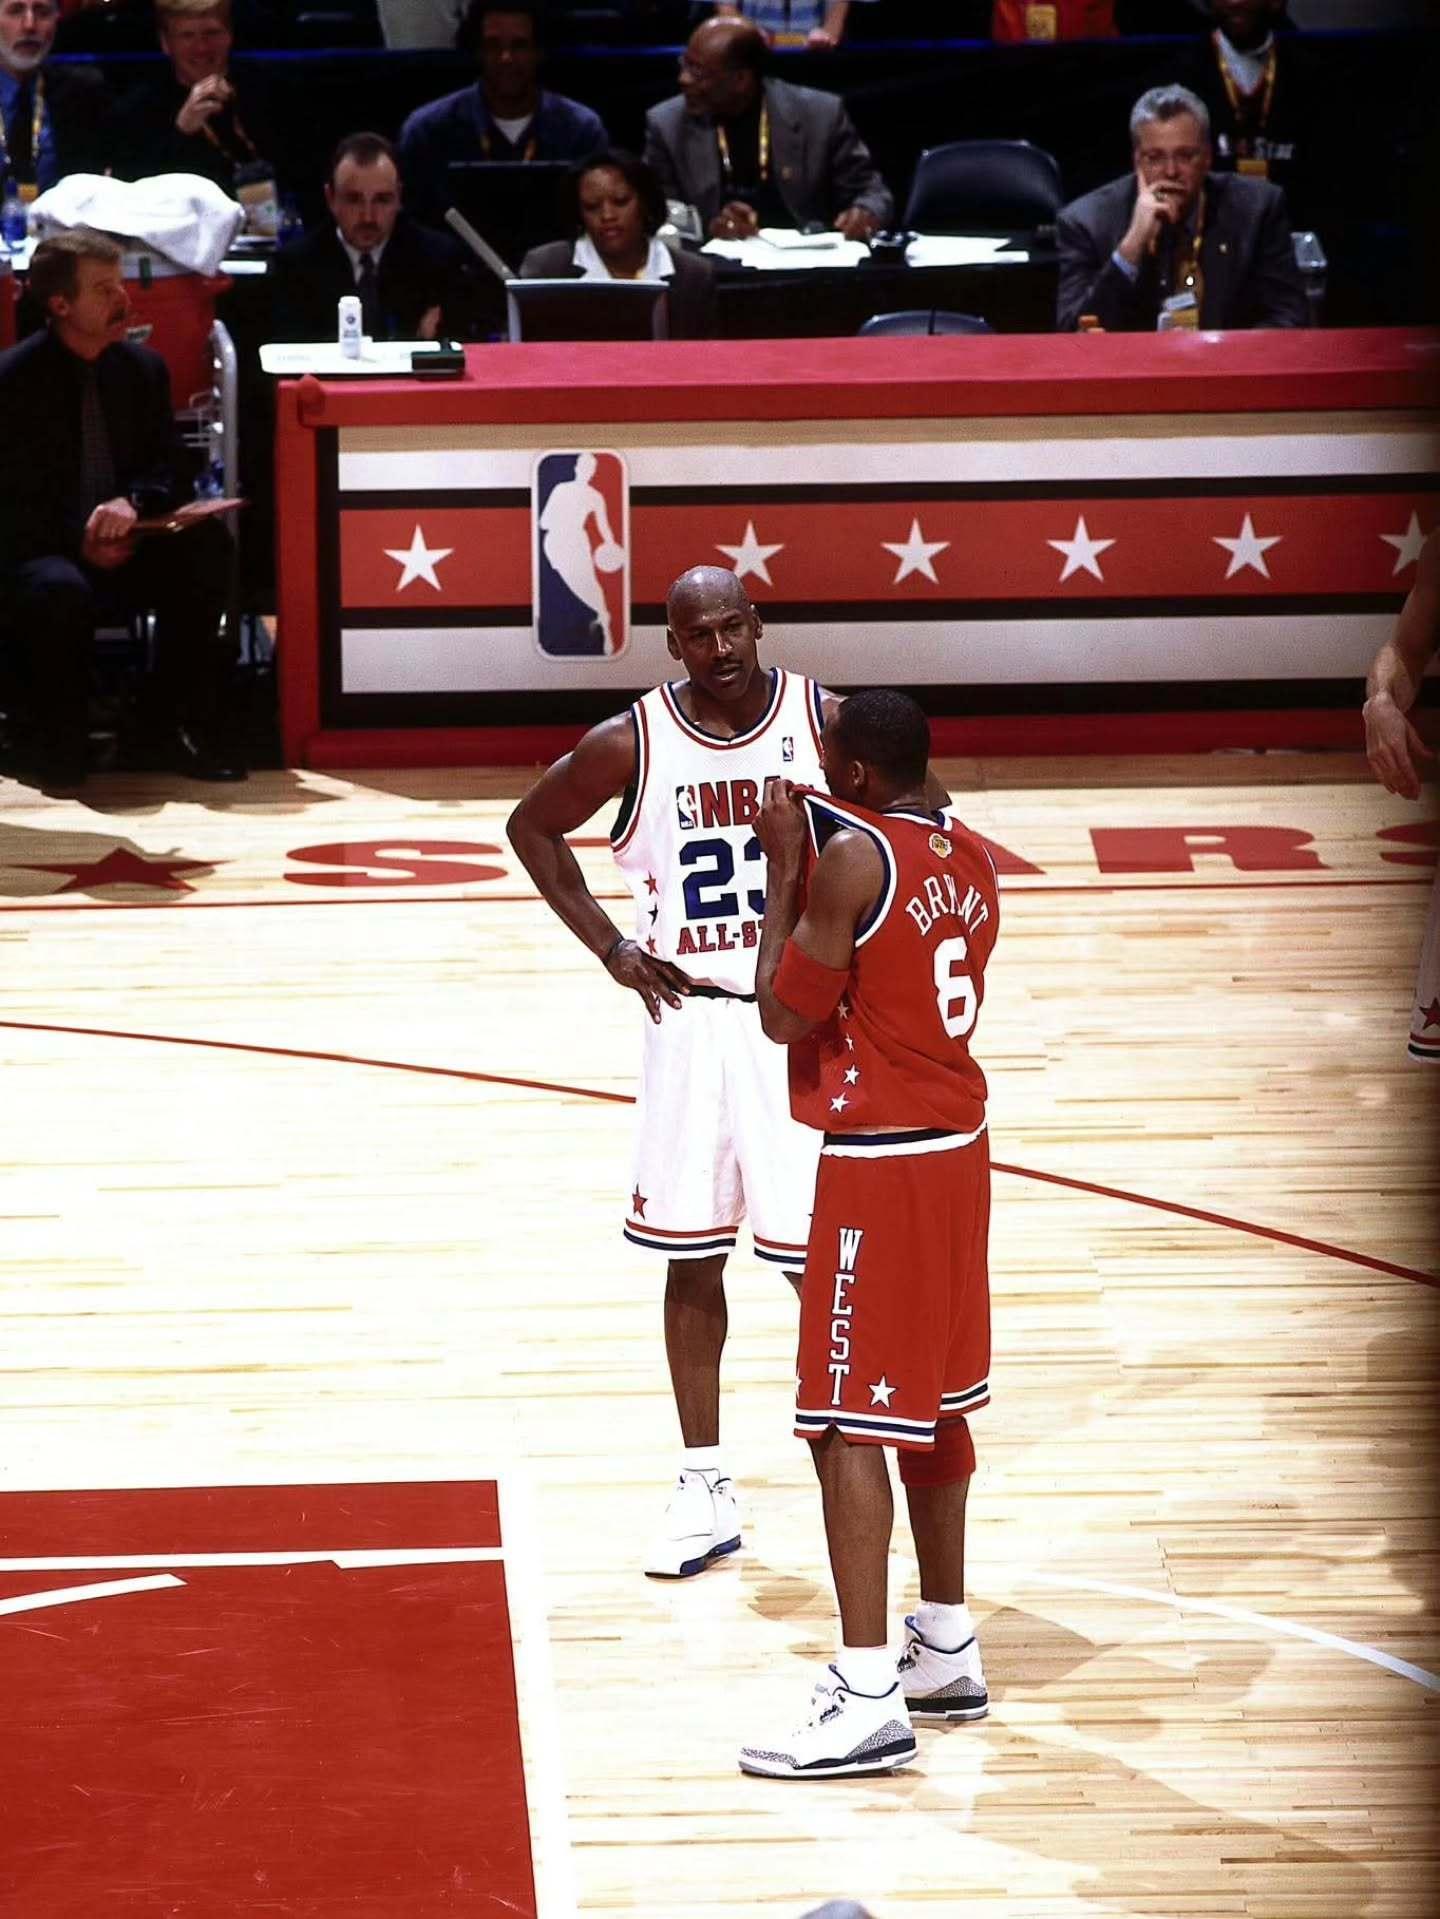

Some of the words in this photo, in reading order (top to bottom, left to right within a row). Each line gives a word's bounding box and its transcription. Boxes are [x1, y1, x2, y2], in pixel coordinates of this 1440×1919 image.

[698, 775, 782, 829] NB
[933, 935, 978, 1039] 6
[828, 1227, 864, 1406] WEST
